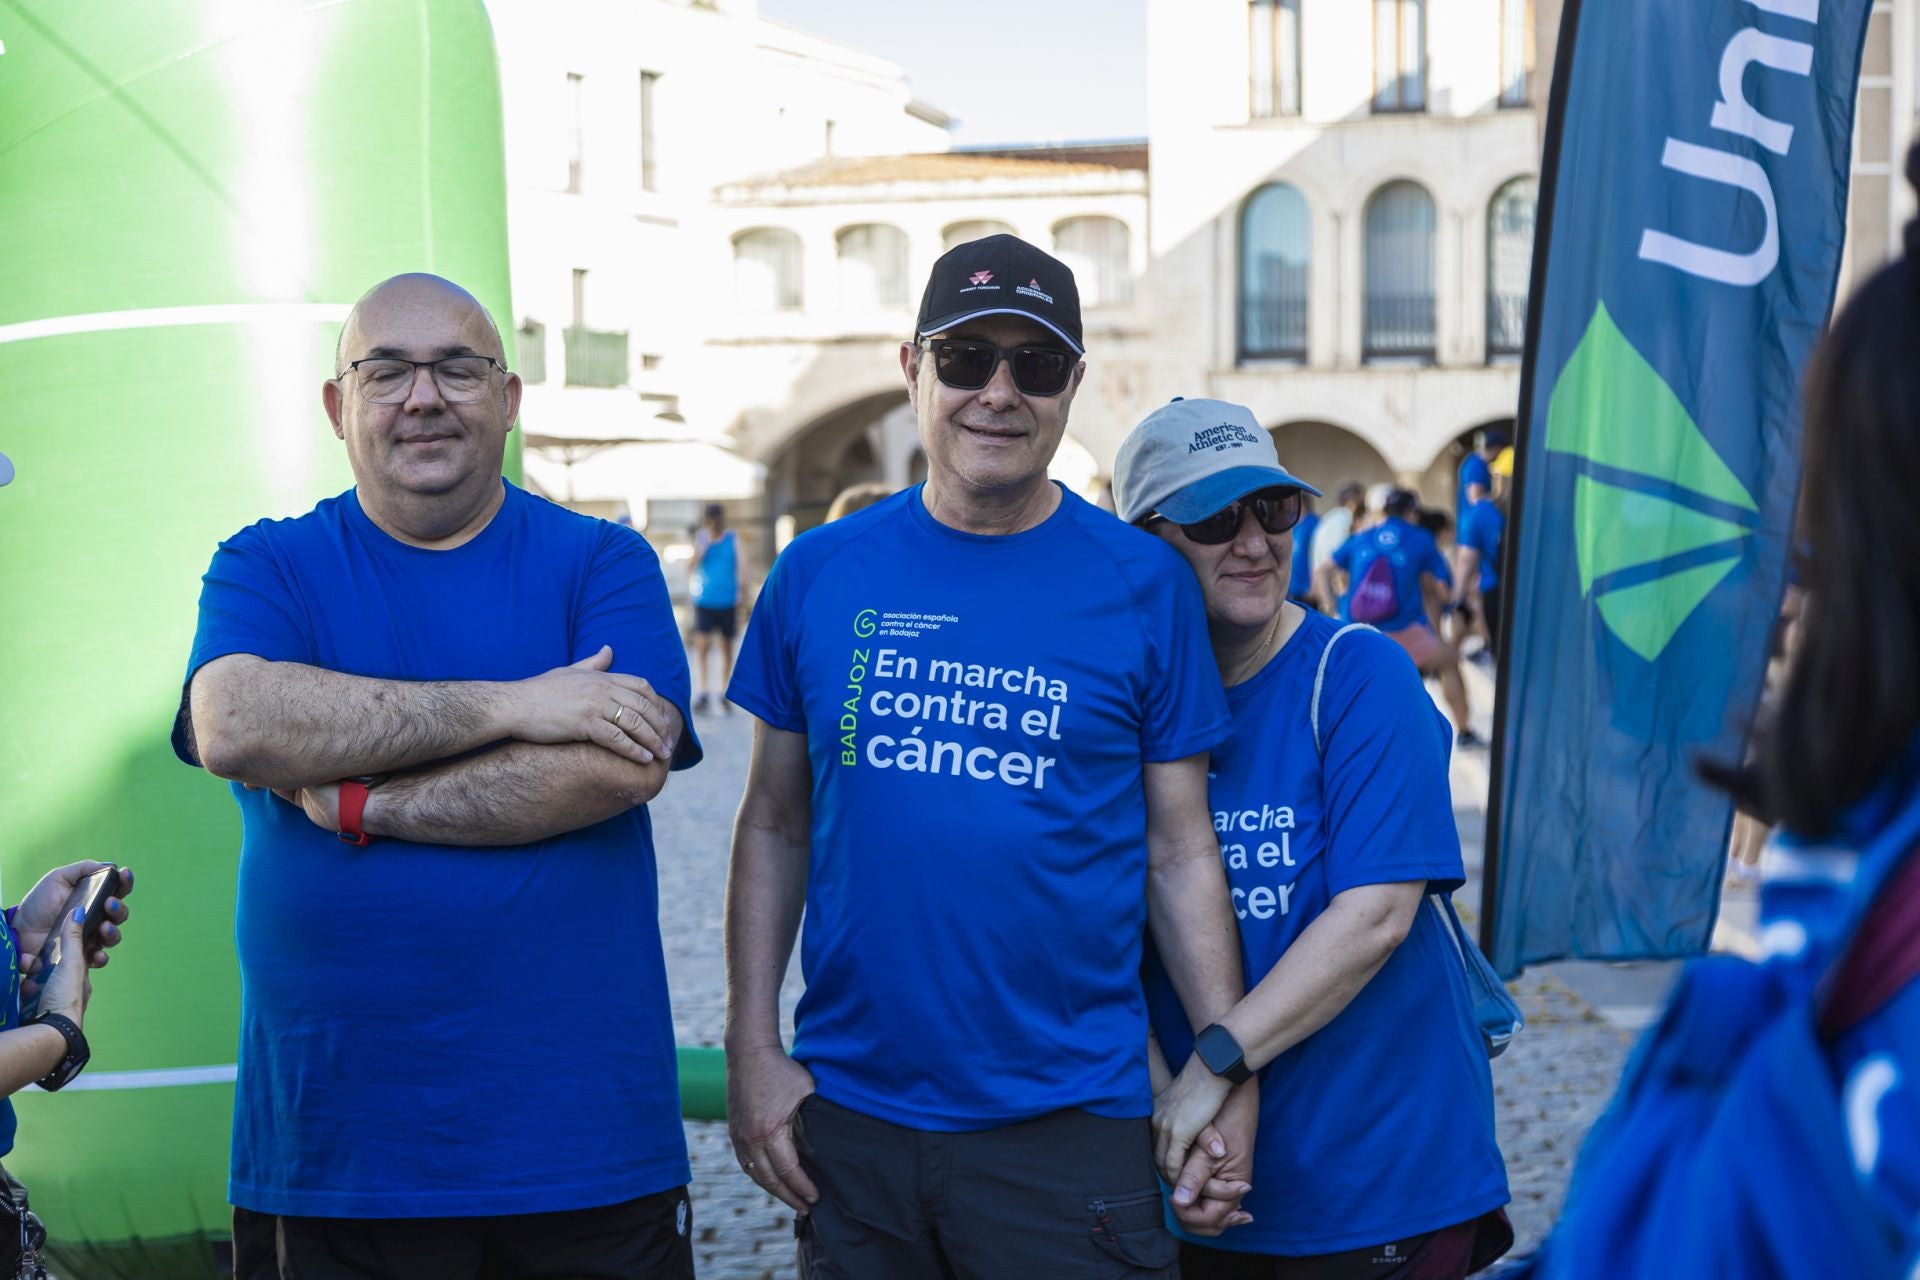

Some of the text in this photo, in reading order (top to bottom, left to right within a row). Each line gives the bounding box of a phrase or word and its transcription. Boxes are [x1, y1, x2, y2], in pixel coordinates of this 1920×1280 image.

[1188, 431, 1259, 455] Athletic Club
[1194, 422, 1247, 442] American
[881, 620, 941, 630] contra el cáncer
[882, 612, 959, 623] asociación española
[889, 628, 920, 638] Badajoz
[874, 648, 1068, 703] En marcha
[840, 648, 871, 767] BADAJOZ
[870, 690, 1062, 741] contra el
[866, 726, 1056, 789] cáncer
[1212, 804, 1296, 832] archa
[1257, 832, 1296, 868] el
[1231, 881, 1296, 920] cer
